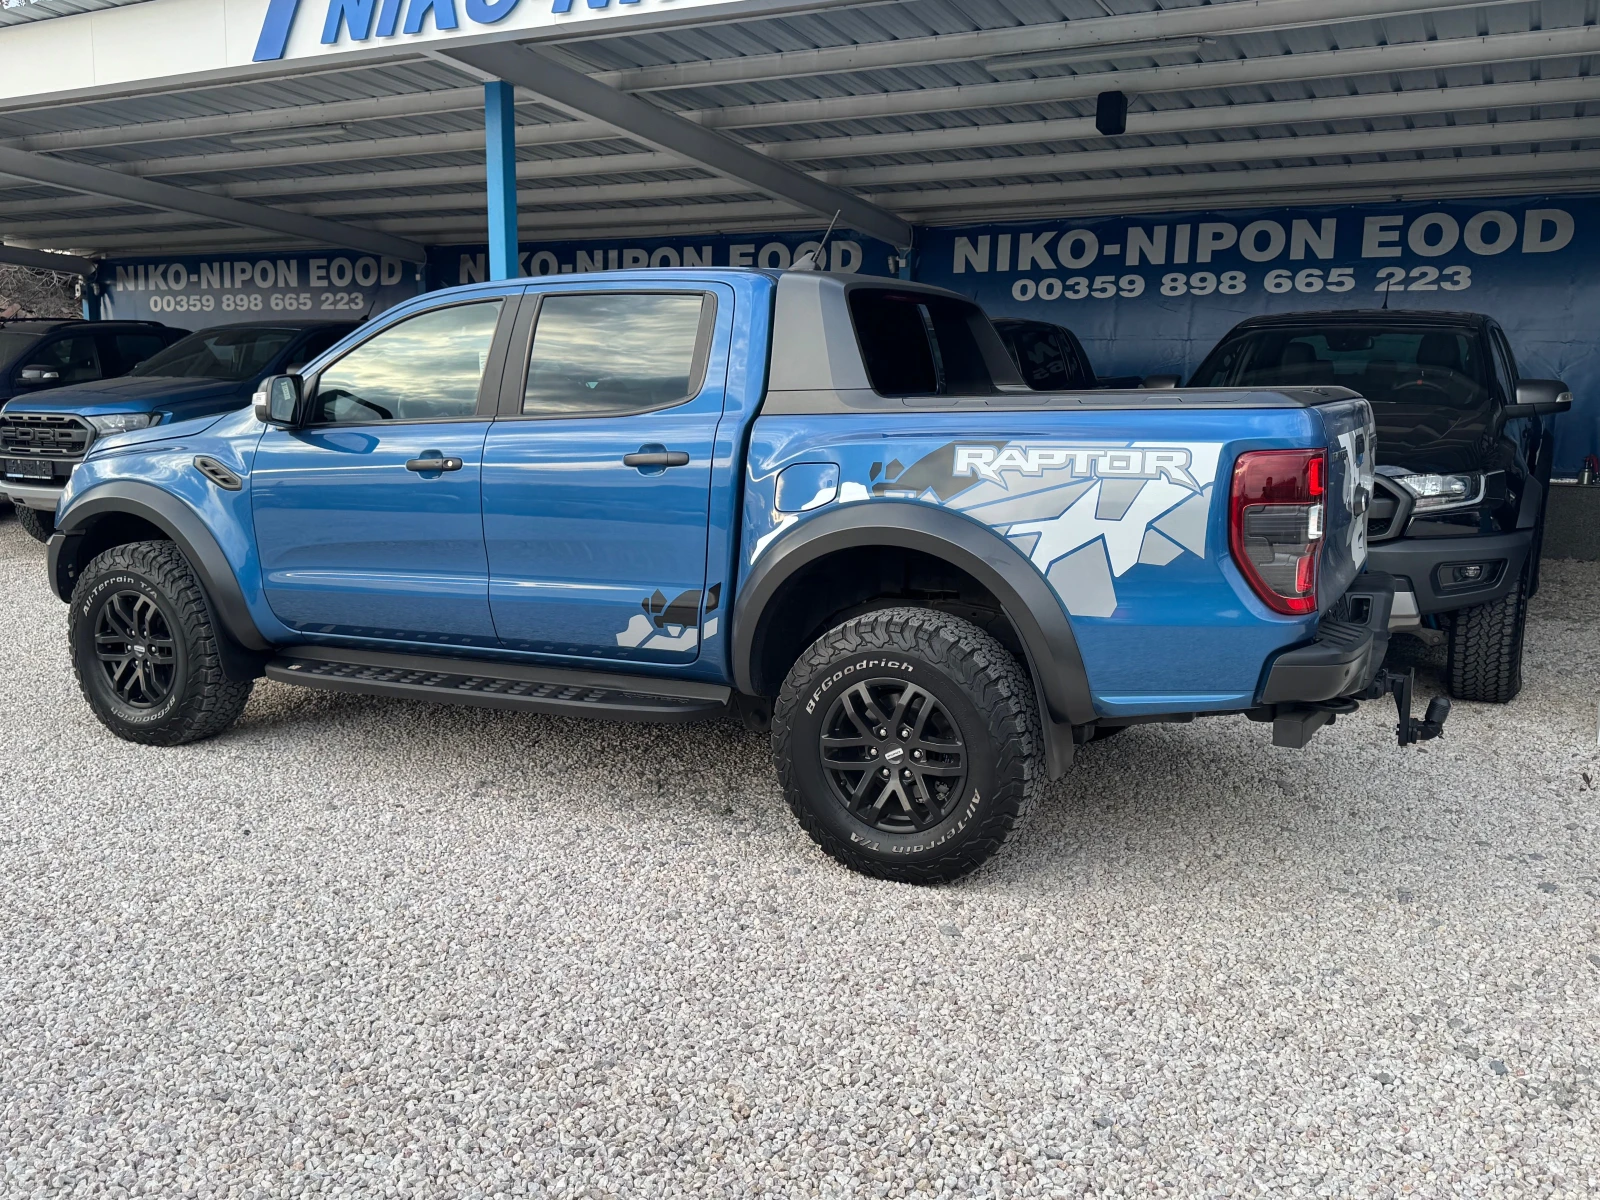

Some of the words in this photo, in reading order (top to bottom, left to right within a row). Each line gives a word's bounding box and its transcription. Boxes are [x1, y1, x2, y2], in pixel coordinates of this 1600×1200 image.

[953, 217, 1337, 274] NIKO-NIPON
[1361, 208, 1575, 258] EOOD
[115, 259, 298, 292] NIKO-NIPON
[309, 256, 402, 287] EOOD
[1011, 274, 1146, 302] 00359
[1160, 270, 1247, 297] 898
[1263, 267, 1356, 294] 665
[1374, 265, 1472, 292] 223
[149, 295, 215, 313] 00359
[221, 293, 263, 312] 898
[270, 293, 312, 311] 665
[320, 292, 364, 310] 223
[953, 445, 1205, 493] RAPTOR
[82, 575, 135, 618] All-Terrain
[139, 580, 159, 600] T/A
[806, 657, 915, 715] BFGoodrich
[110, 694, 176, 723] BFGoodrich
[849, 831, 881, 852] T/A
[891, 788, 981, 855] All-Terrain
